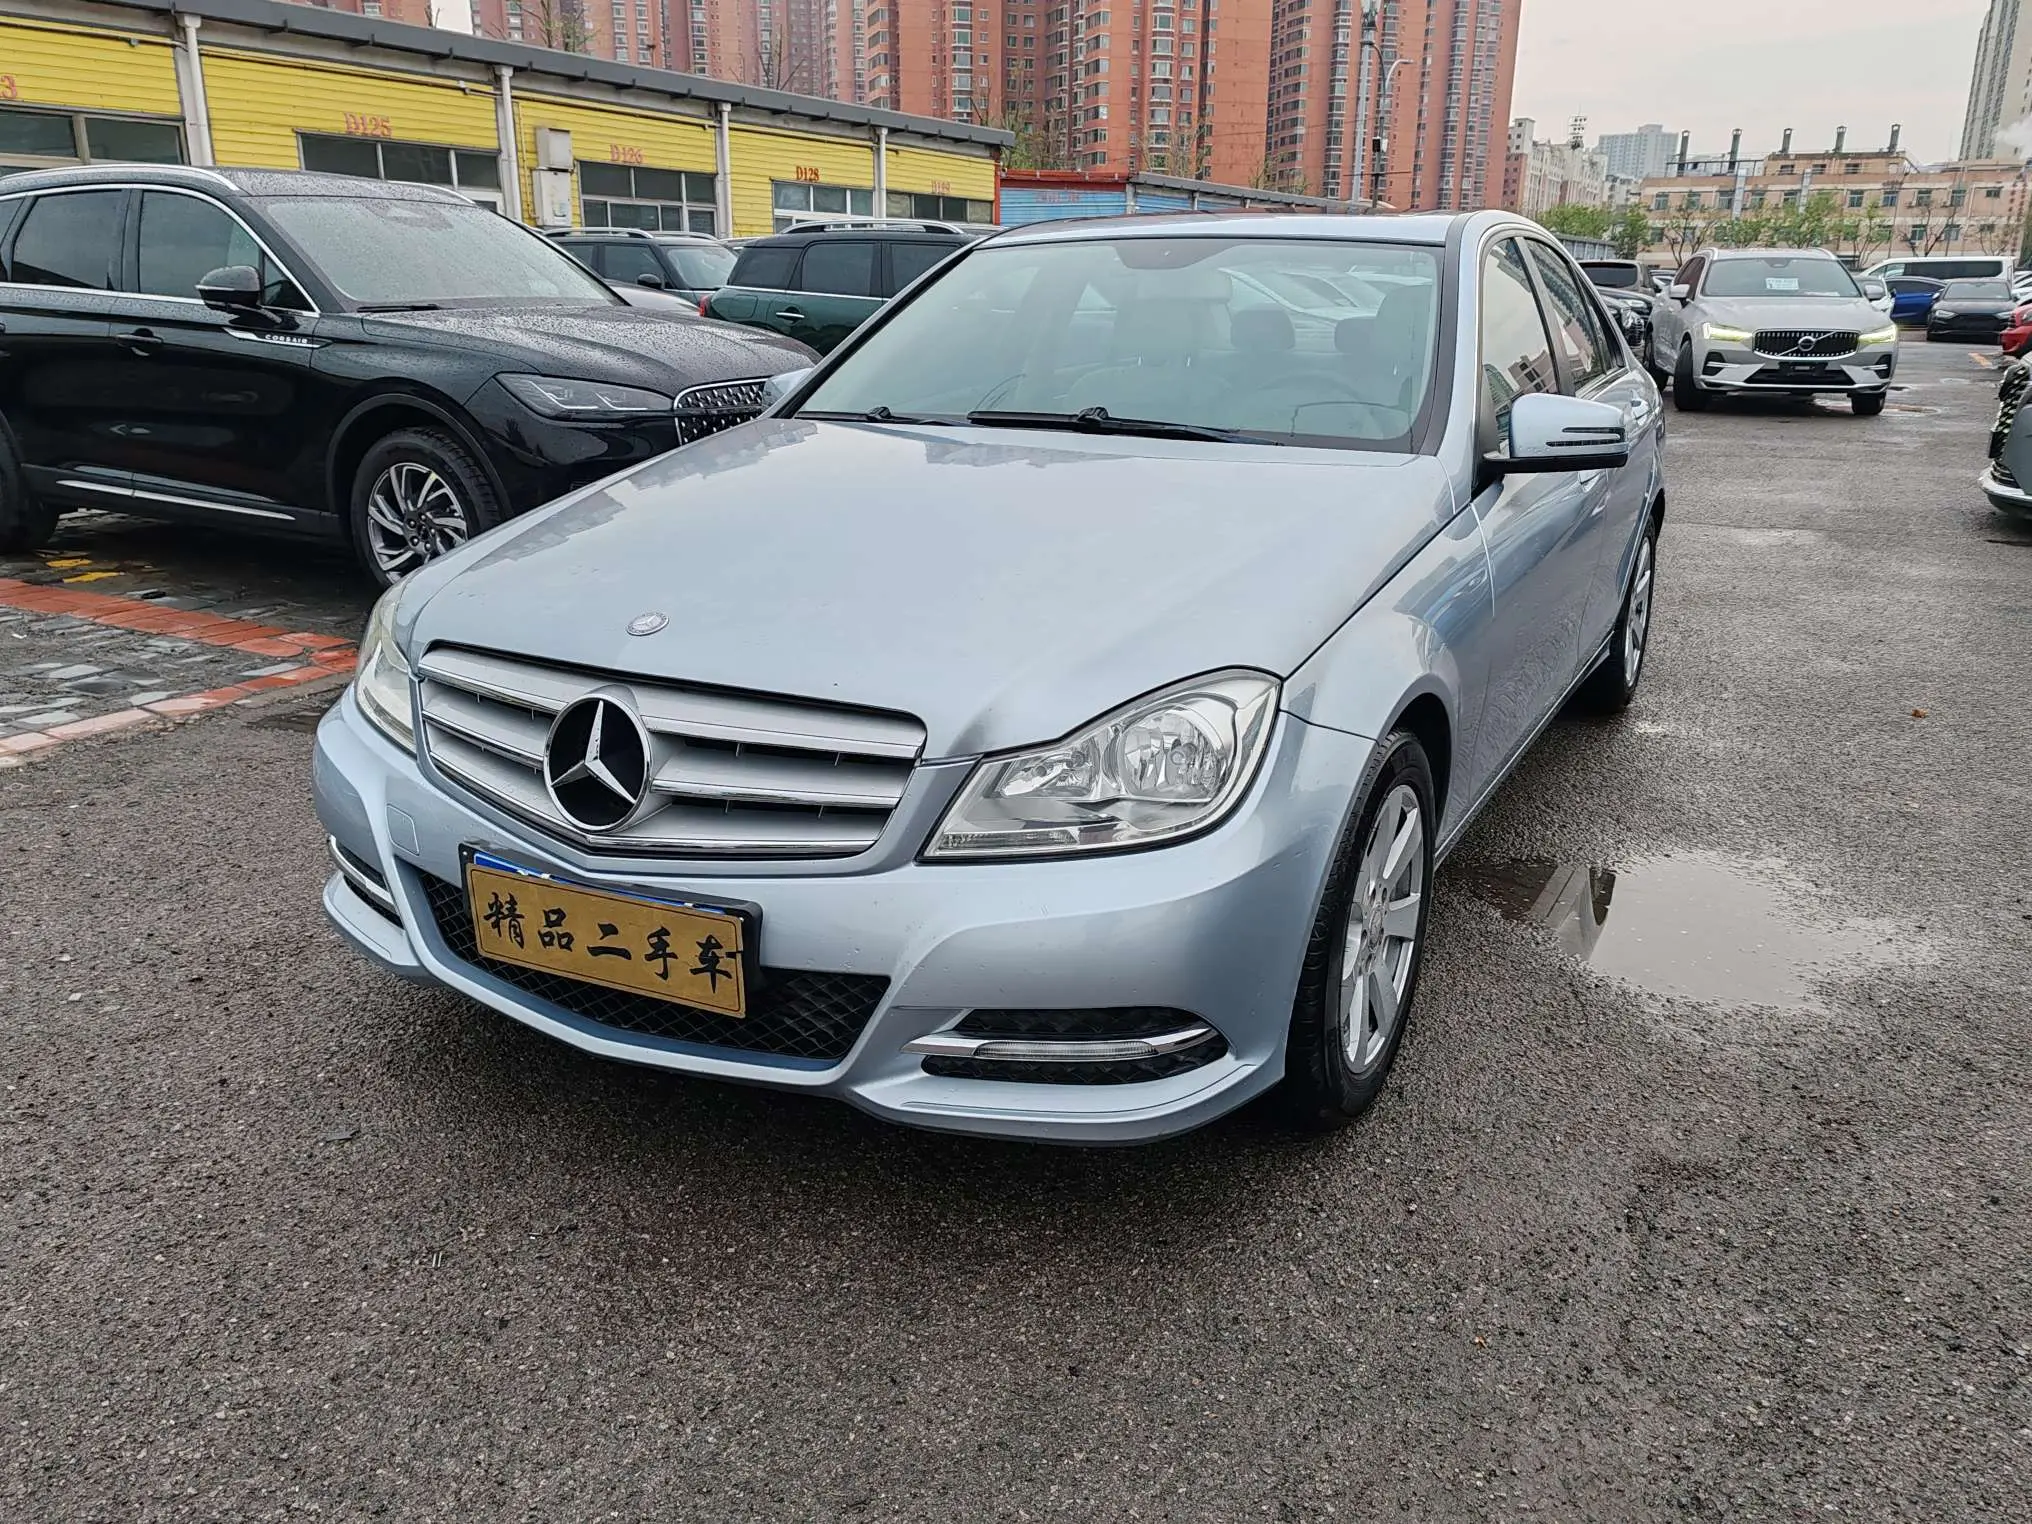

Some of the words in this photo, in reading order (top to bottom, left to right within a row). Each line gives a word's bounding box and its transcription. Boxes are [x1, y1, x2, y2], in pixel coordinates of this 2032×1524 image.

[344, 111, 393, 137] D125
[610, 143, 645, 164] D126
[796, 165, 820, 183] D128
[265, 334, 308, 344] CORSAIR
[483, 891, 733, 994] 精品二手车
